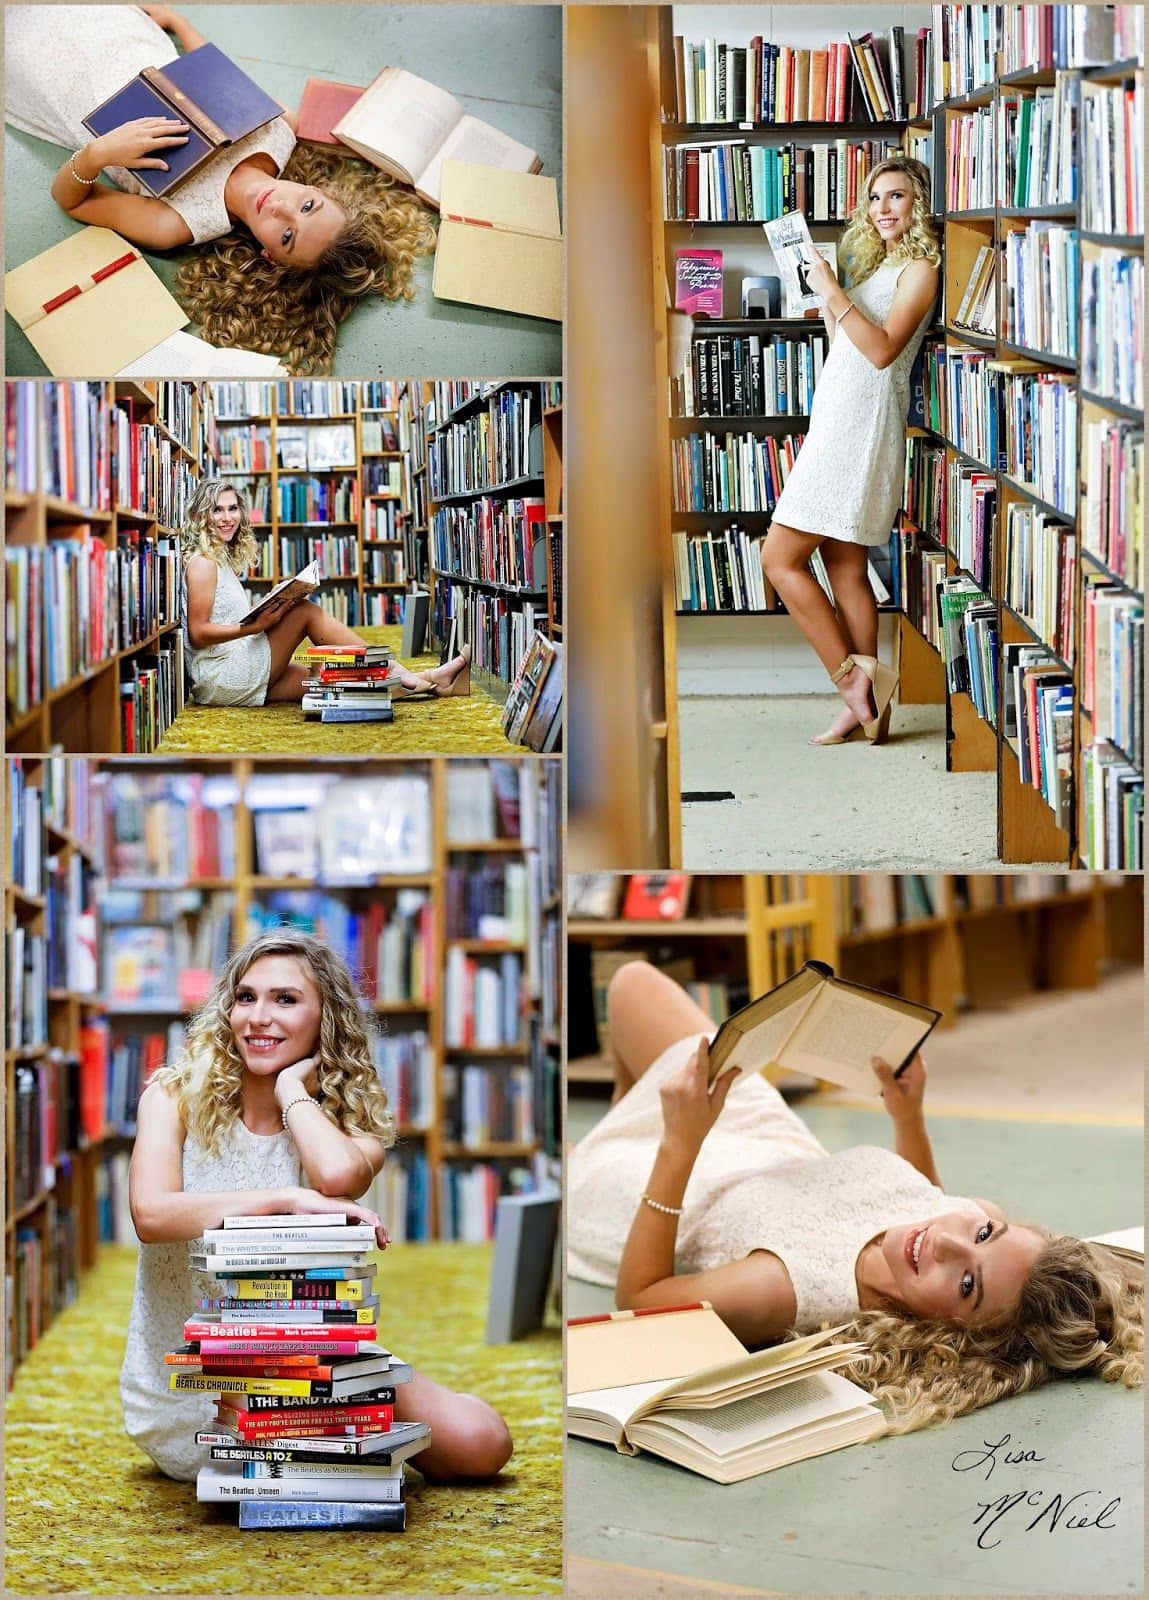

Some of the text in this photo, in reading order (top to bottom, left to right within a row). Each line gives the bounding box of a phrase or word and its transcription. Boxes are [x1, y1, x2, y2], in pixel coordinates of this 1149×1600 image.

[252, 1281, 280, 1290] Revolution
[209, 1326, 257, 1337] Beatles
[176, 1379, 205, 1390] BEATLES
[206, 1380, 248, 1392] CHRONICLE
[256, 1396, 279, 1408] THE
[277, 1441, 299, 1449] Digest
[213, 1449, 292, 1461] THE BEATLES A TO Z
[220, 1486, 230, 1495] The
[232, 1486, 255, 1495] Beatles
[258, 1487, 280, 1495] Unseen
